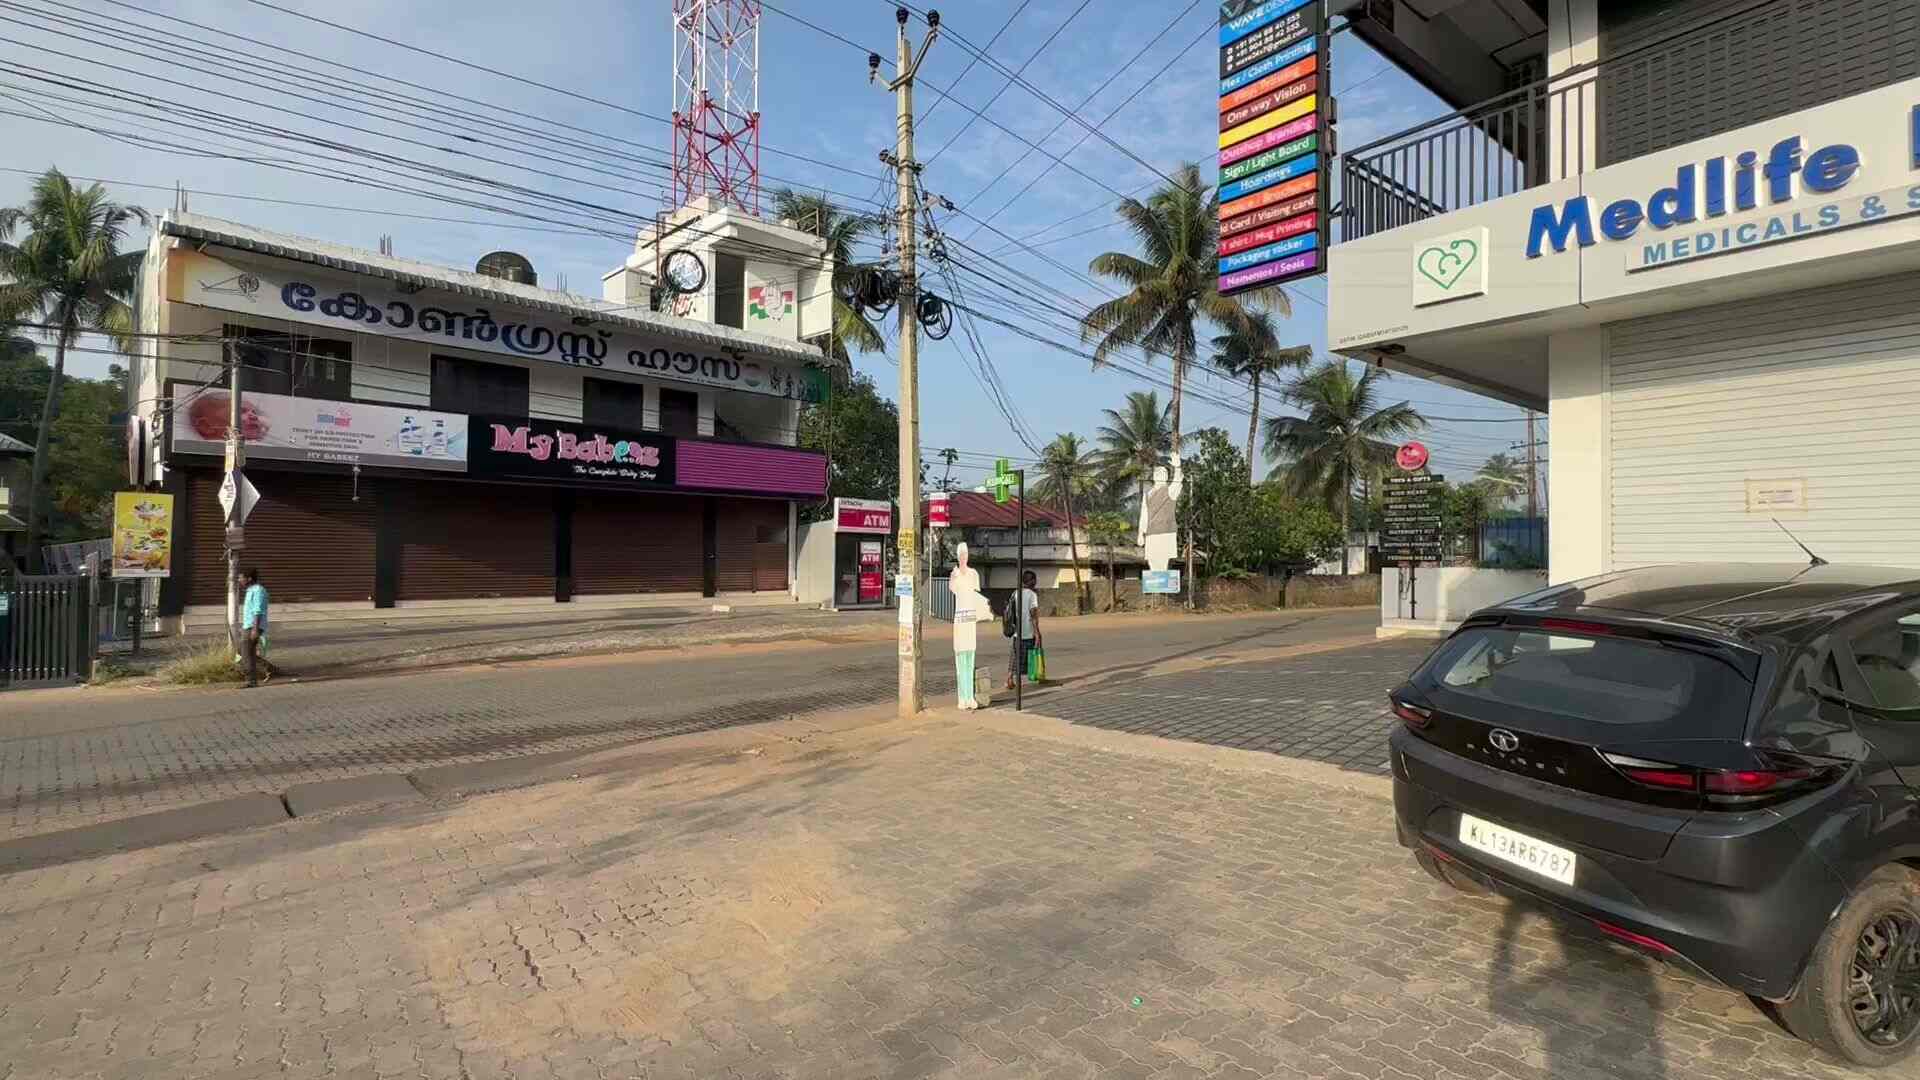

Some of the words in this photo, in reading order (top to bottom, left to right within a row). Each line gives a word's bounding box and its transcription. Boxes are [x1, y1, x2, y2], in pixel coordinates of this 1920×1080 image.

[1227, 108, 1249, 124] One
[1250, 98, 1272, 112] way
[1273, 82, 1307, 102] Vision
[1224, 166, 1245, 179] Sign
[1251, 150, 1276, 168] Light
[1278, 137, 1310, 158] Board
[1240, 165, 1292, 191] Hoardings
[1230, 217, 1251, 228] Card
[1257, 204, 1291, 221] Visiting
[1292, 195, 1315, 210] card
[1526, 135, 1862, 259] Medlife
[1276, 216, 1313, 235] Printing
[1643, 206, 1839, 265] MEDICALS
[1861, 195, 1886, 221] &
[1280, 258, 1305, 273] Seals
[490, 424, 553, 461] My
[863, 514, 889, 527] ATM
[931, 504, 945, 513] ATM
[862, 554, 879, 562] ATM
[1469, 824, 1572, 876] KL13AR6787
